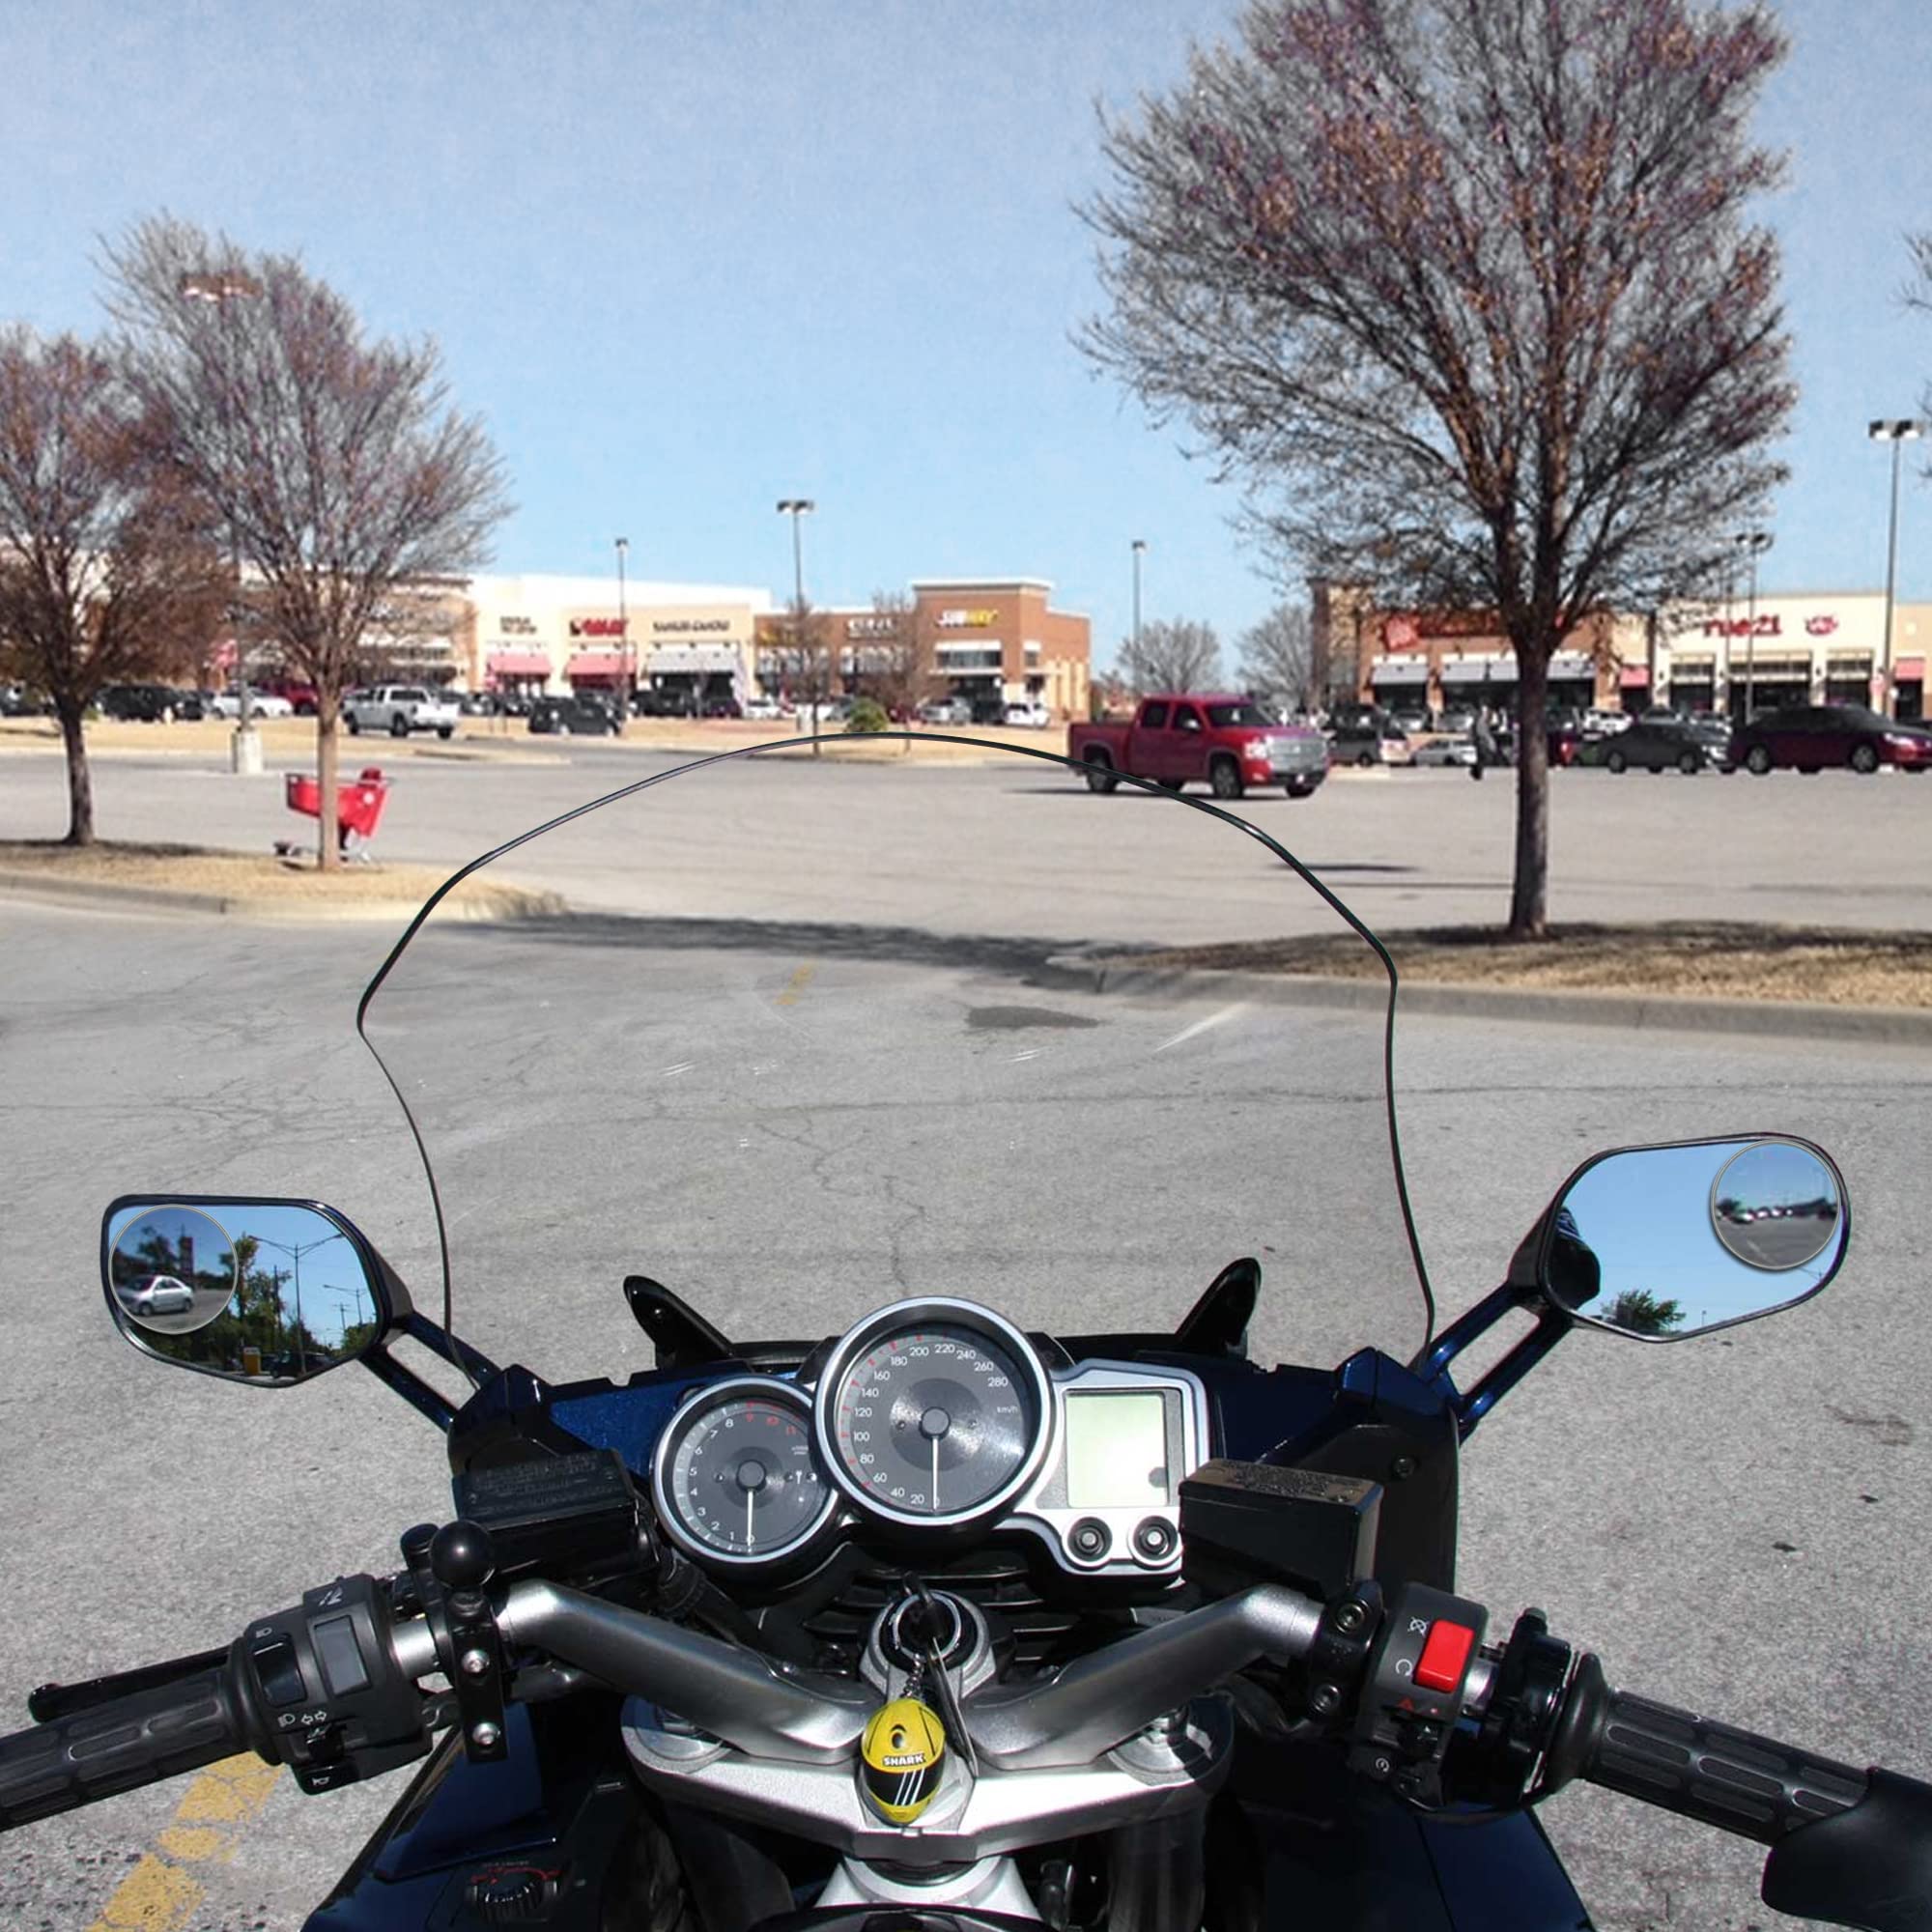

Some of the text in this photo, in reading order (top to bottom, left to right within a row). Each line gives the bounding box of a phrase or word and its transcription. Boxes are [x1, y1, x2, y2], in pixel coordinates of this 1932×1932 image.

[909, 1347, 929, 1357] 200
[934, 1344, 955, 1354] 220
[956, 1350, 976, 1360] 240
[890, 1355, 908, 1367] 180
[974, 1361, 994, 1372] 260
[873, 1371, 891, 1381] 160
[987, 1377, 1009, 1387] 280
[862, 1387, 879, 1398] 140
[854, 1406, 872, 1417] 120
[724, 1418, 734, 1428] 8
[710, 1429, 719, 1438] 7
[853, 1431, 870, 1441] 100
[695, 1446, 703, 1456] 6
[860, 1453, 874, 1464] 80
[689, 1467, 697, 1476] 5
[873, 1472, 888, 1484] 60
[690, 1488, 697, 1496] 4
[891, 1487, 905, 1497] 40
[910, 1493, 924, 1505] 20
[697, 1507, 706, 1517] 3
[711, 1520, 720, 1530] 2
[729, 1531, 735, 1540] 1
[883, 1753, 925, 1766] SHARK
